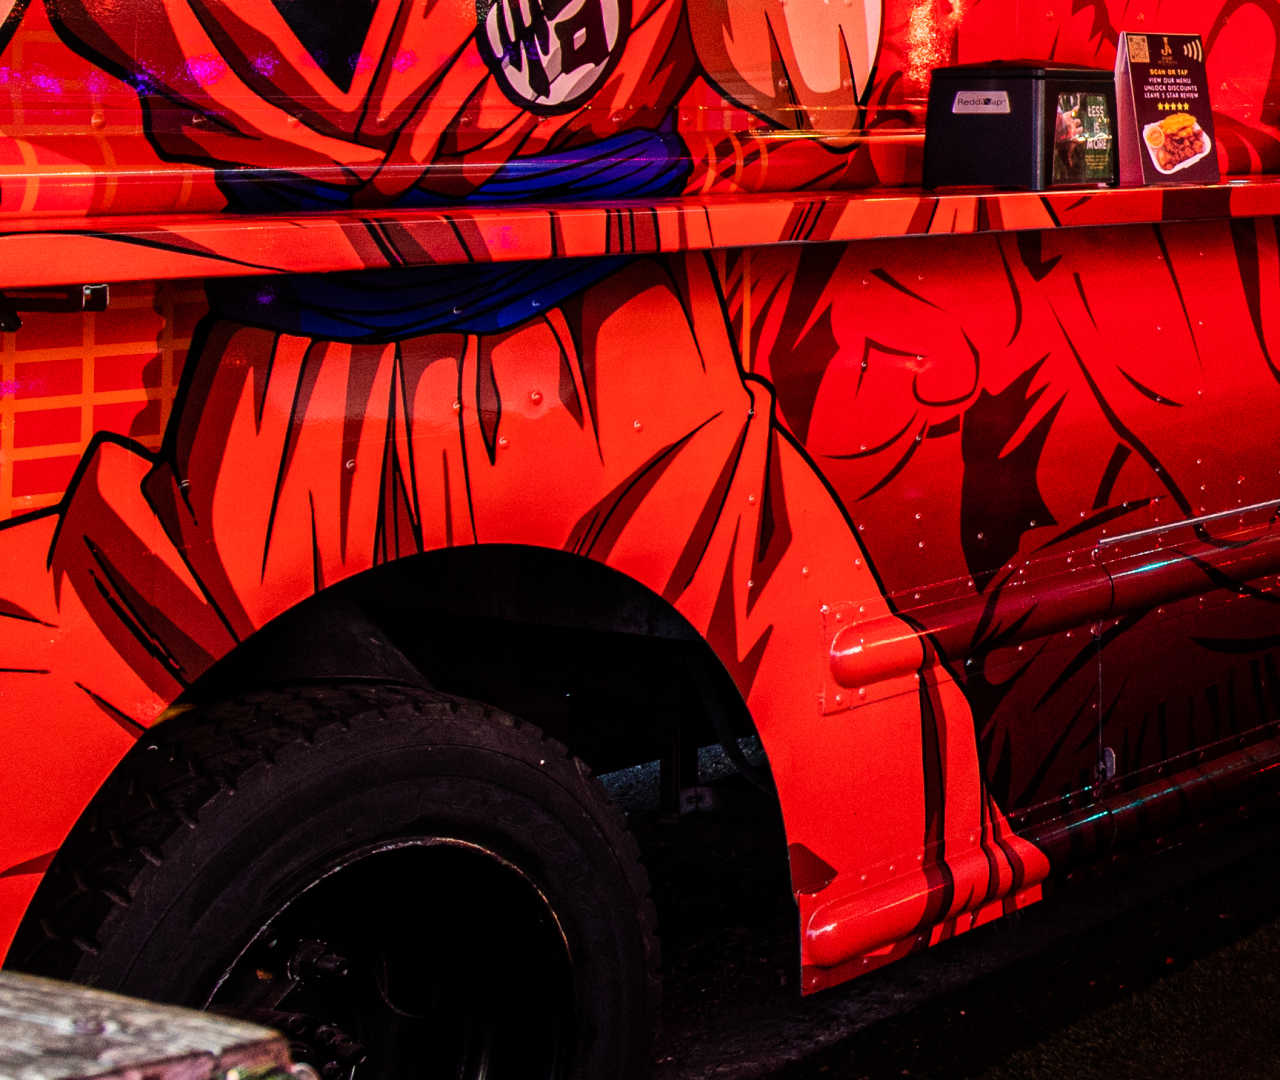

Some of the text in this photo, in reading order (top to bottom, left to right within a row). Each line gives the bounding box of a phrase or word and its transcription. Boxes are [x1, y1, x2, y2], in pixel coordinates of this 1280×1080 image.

[1143, 84, 1198, 92] UNLOCK DISCOUNTS
[1087, 105, 1105, 118] LESS
[1086, 138, 1107, 150] MORE
